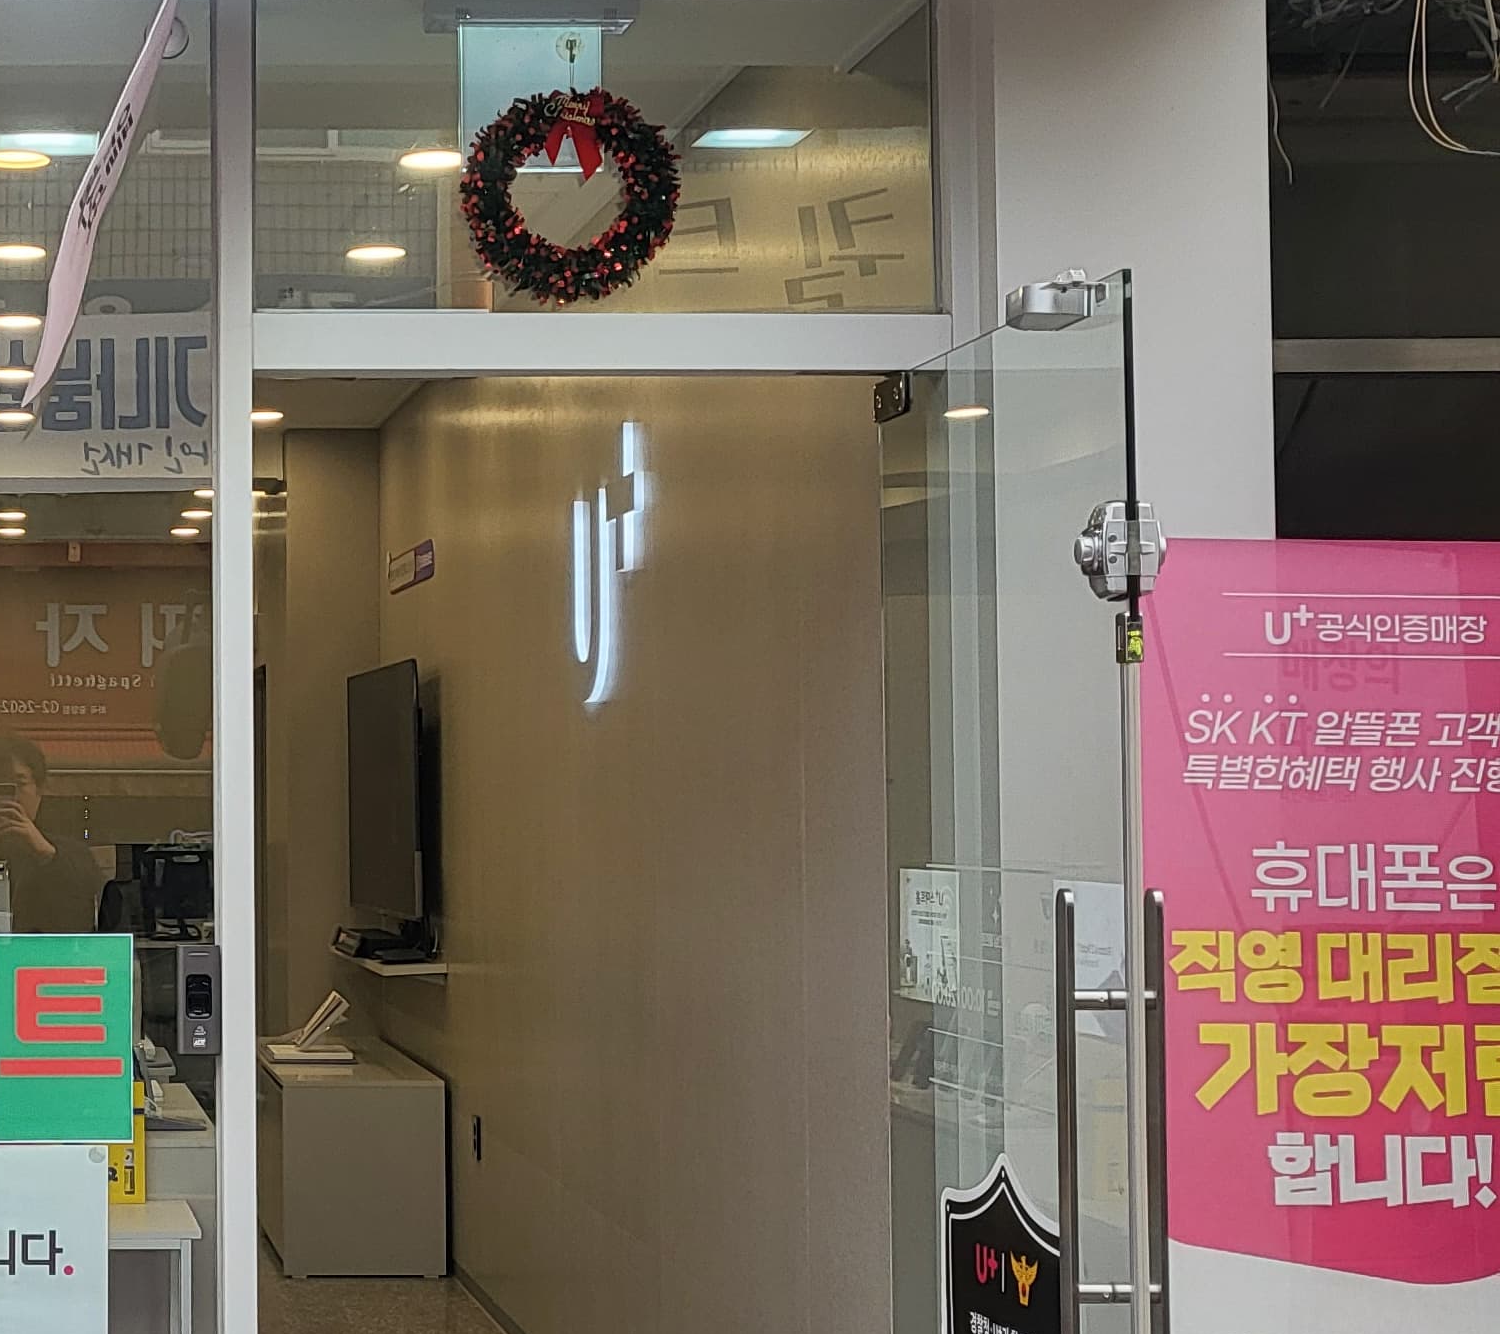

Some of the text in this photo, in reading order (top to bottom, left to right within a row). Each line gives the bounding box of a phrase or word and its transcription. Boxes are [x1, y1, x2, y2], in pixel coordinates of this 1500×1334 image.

[1314, 711, 1422, 748] 알뜰폰
[1183, 754, 1362, 792] 특별한혜택
[1369, 756, 1442, 793] 행사
[1251, 840, 1498, 913] 휴대폰은
[1169, 929, 1304, 1004] 직영
[1267, 1131, 1498, 1209] 합니다!
[975, 1242, 999, 1284] U+
